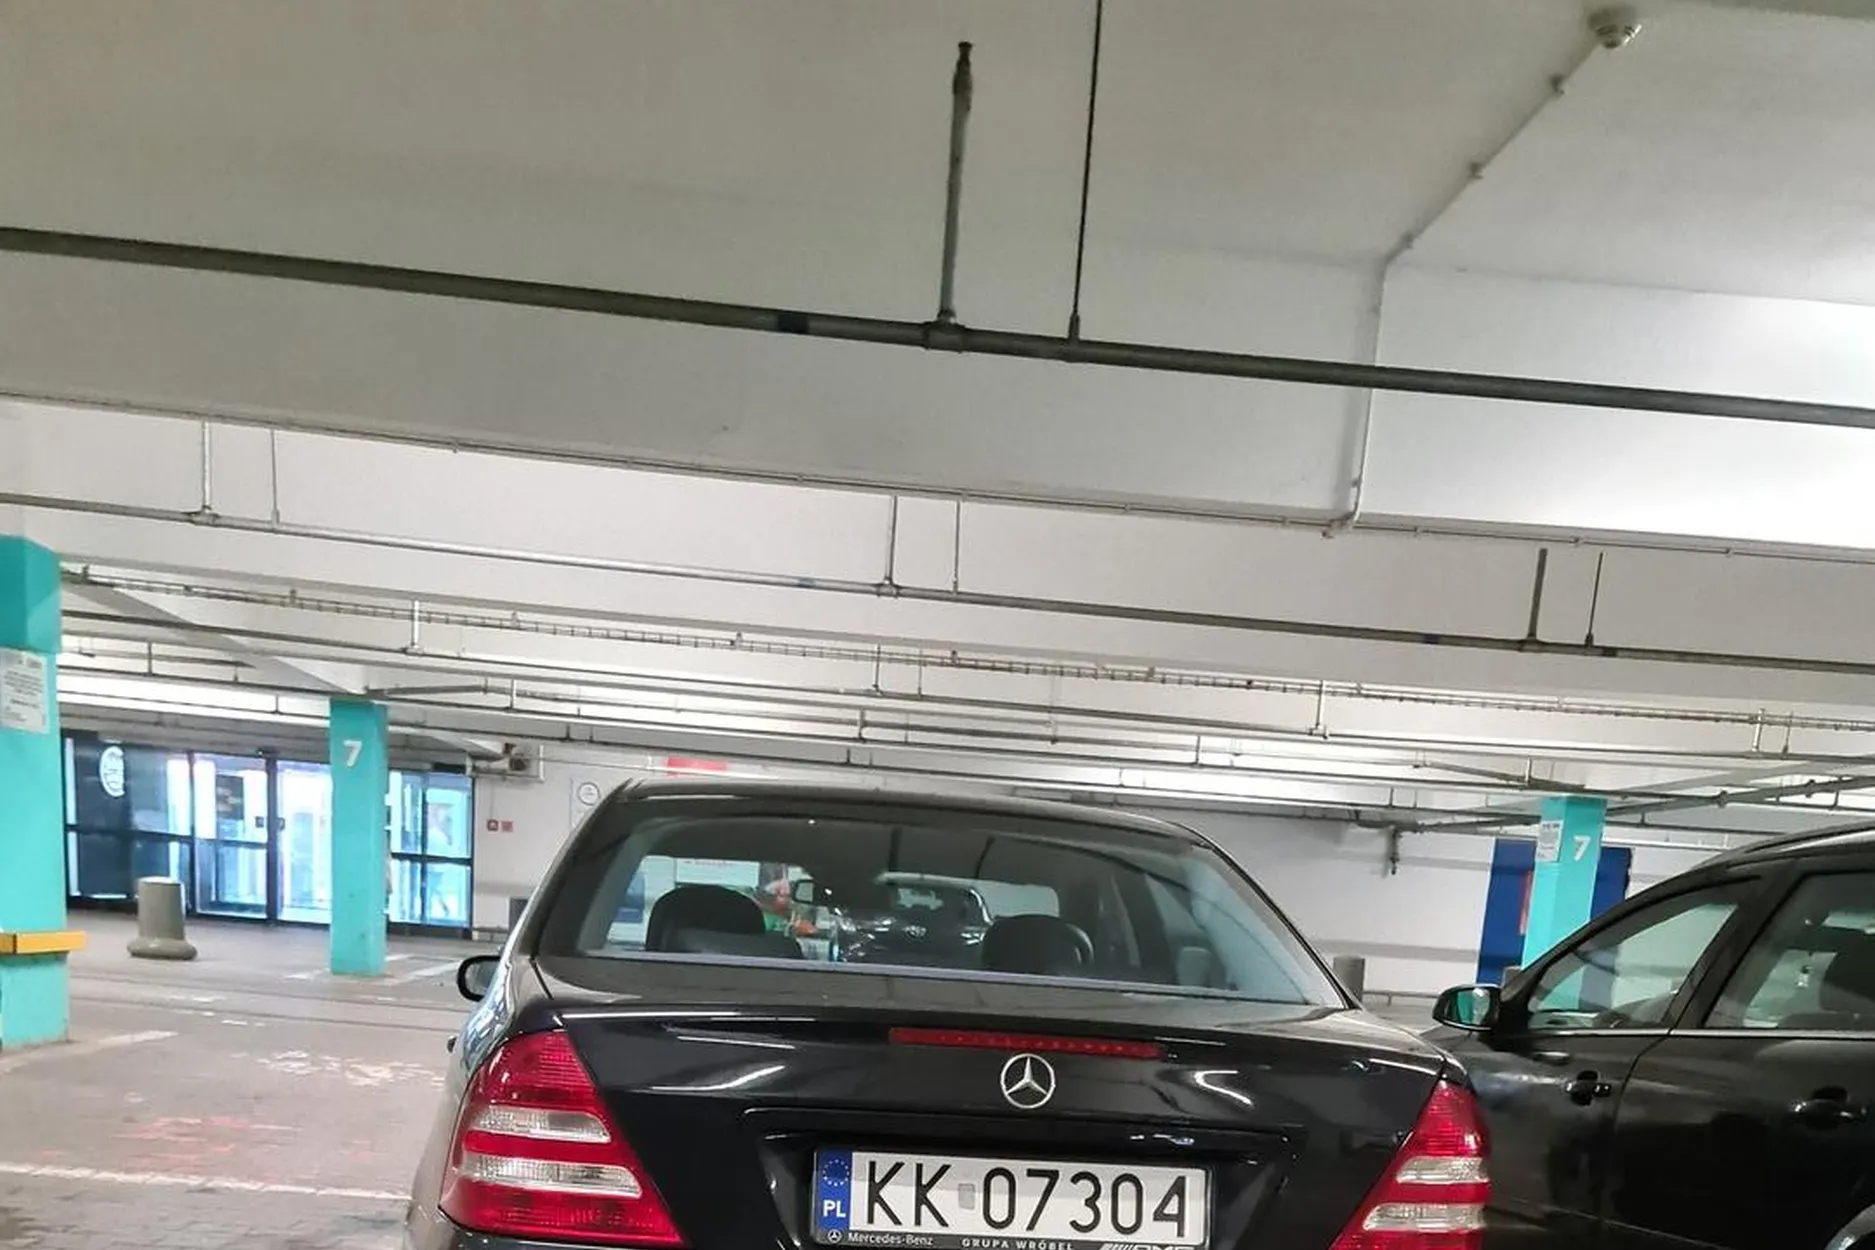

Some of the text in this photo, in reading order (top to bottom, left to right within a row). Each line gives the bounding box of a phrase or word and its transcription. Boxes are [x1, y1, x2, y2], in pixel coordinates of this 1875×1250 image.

[343, 740, 362, 768] 7
[1573, 835, 1591, 862] 7
[822, 1199, 846, 1218] PL
[867, 1160, 1186, 1238] KK 07304
[848, 1231, 934, 1247] Mercedes-Benz
[961, 1237, 1009, 1250] GRUPA
